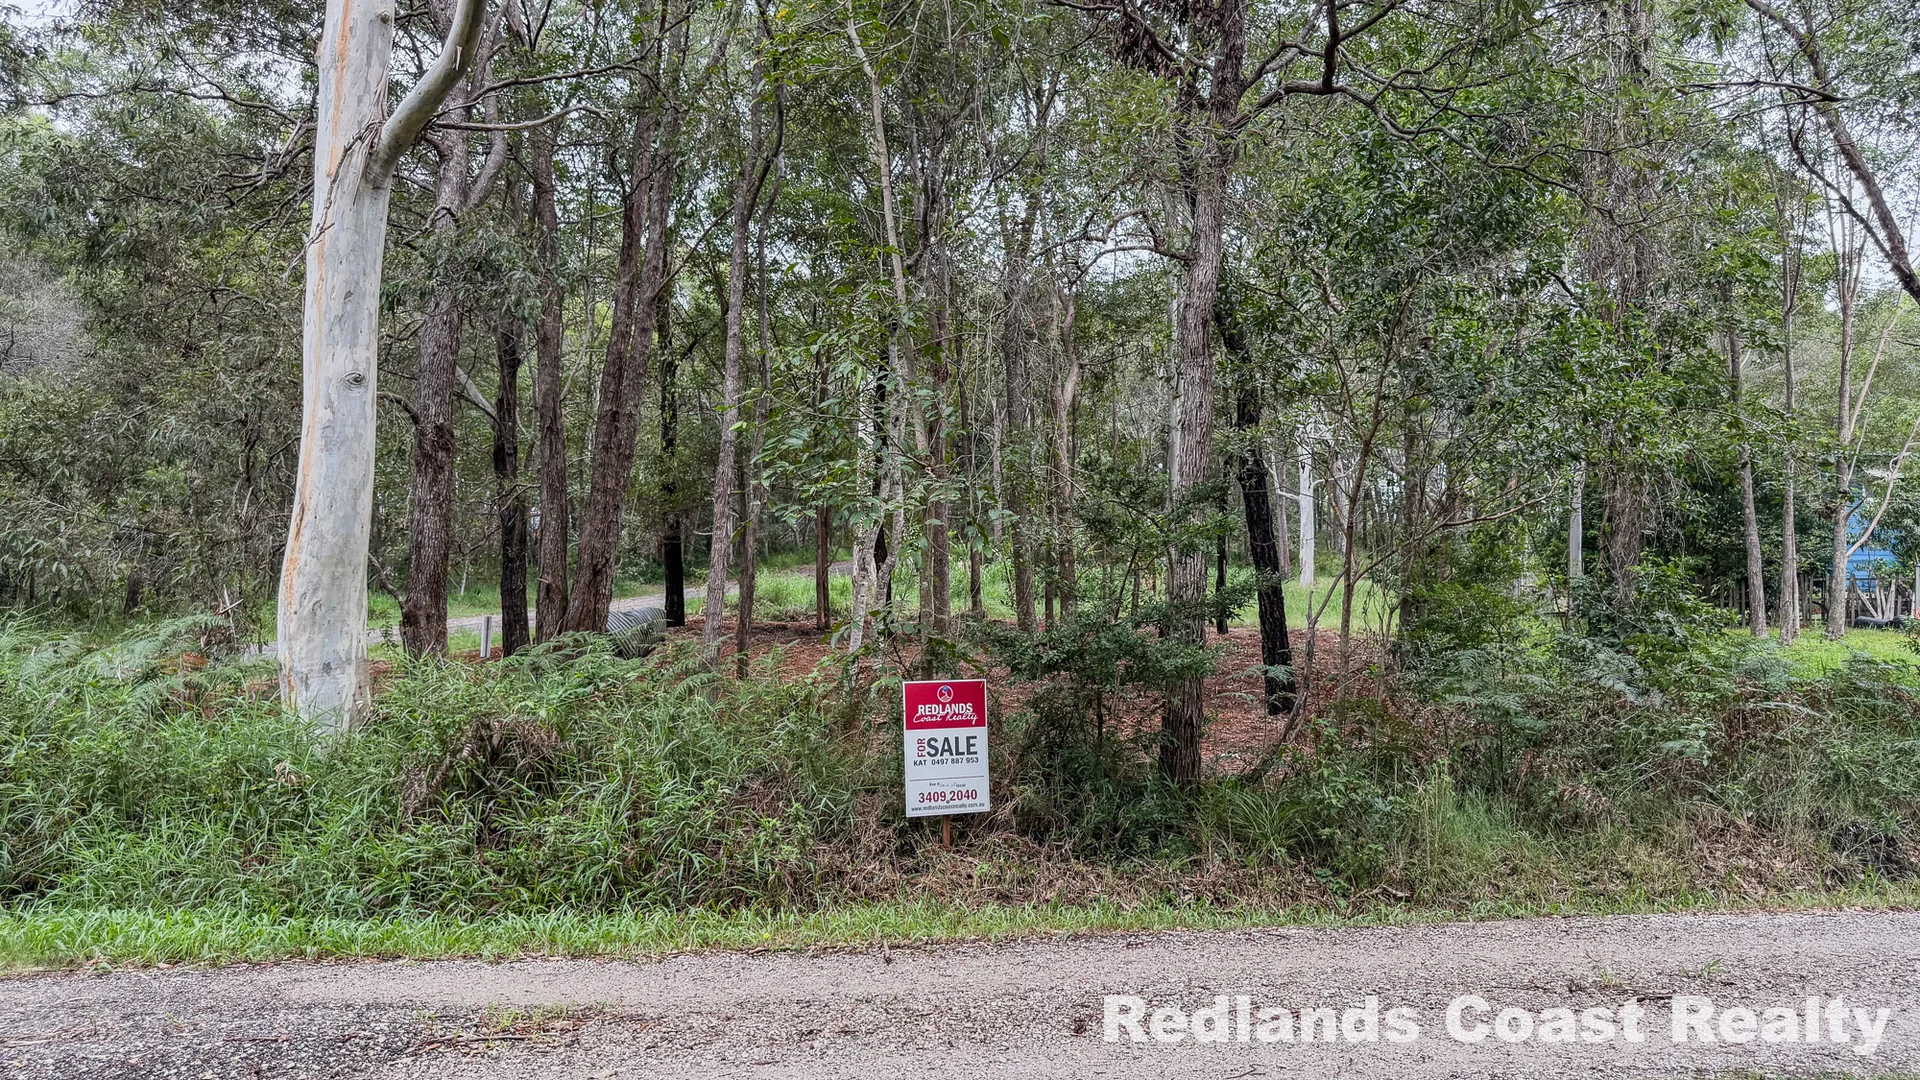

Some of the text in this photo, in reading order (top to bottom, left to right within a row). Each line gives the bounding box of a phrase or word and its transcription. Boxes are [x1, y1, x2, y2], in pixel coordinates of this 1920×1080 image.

[918, 703, 973, 715] REDLANDS
[913, 711, 978, 725] Coast Realty
[917, 738, 926, 757] FOR
[926, 735, 978, 757] SALE
[913, 756, 979, 767] KAT 0497 887 953
[918, 788, 978, 803] 3409 2040
[911, 802, 985, 812] www.redlandscoastrealty.com.au
